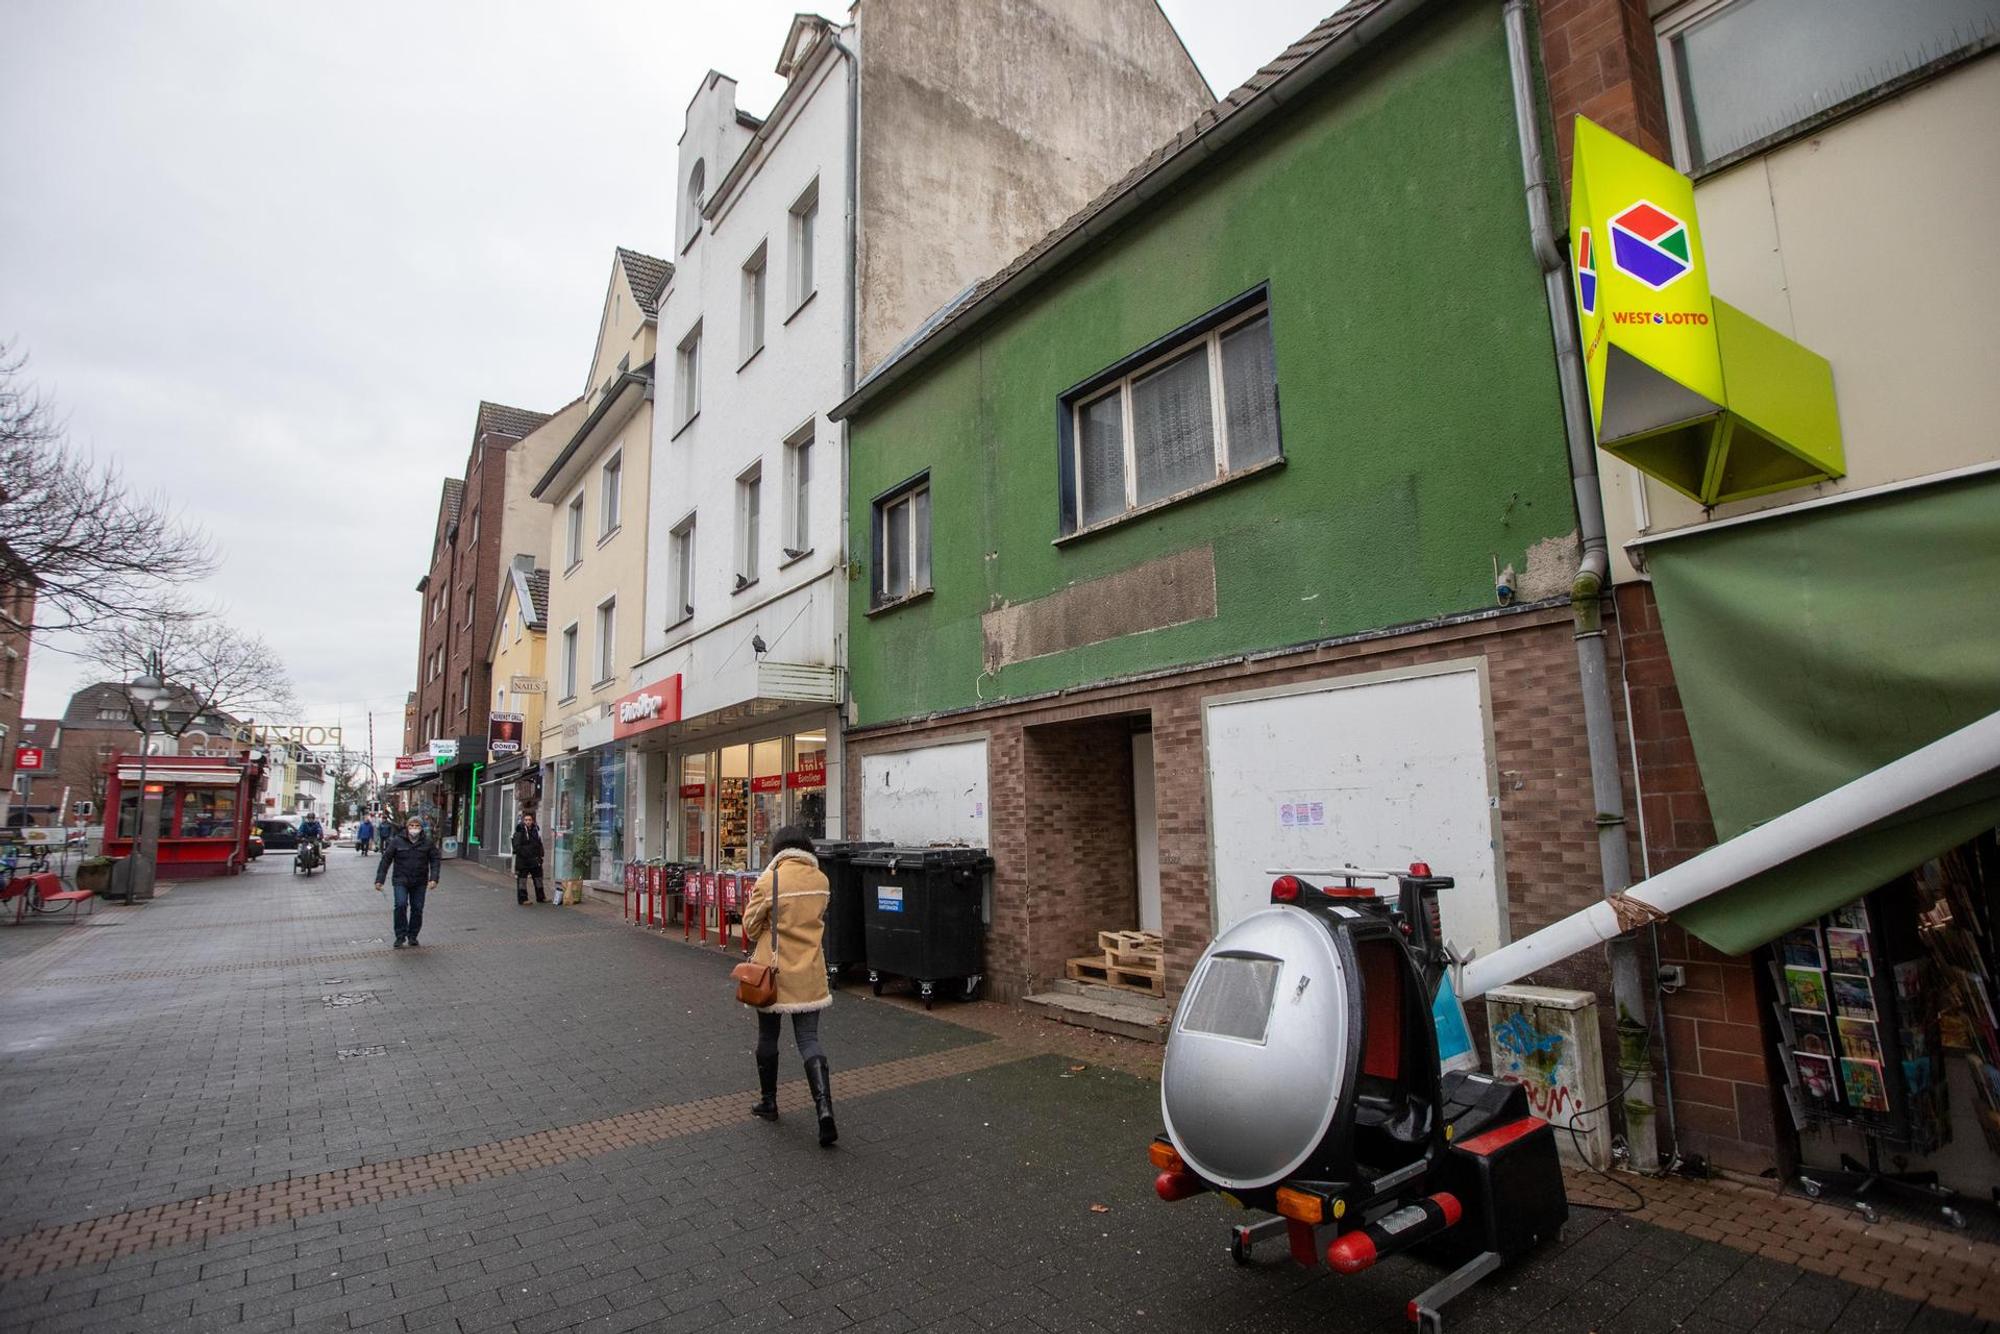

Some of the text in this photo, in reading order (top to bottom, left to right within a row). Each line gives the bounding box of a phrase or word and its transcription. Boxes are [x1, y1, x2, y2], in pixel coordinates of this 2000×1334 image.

[1613, 311, 1709, 326] WEST LOTTO
[514, 683, 541, 691] NAILS
